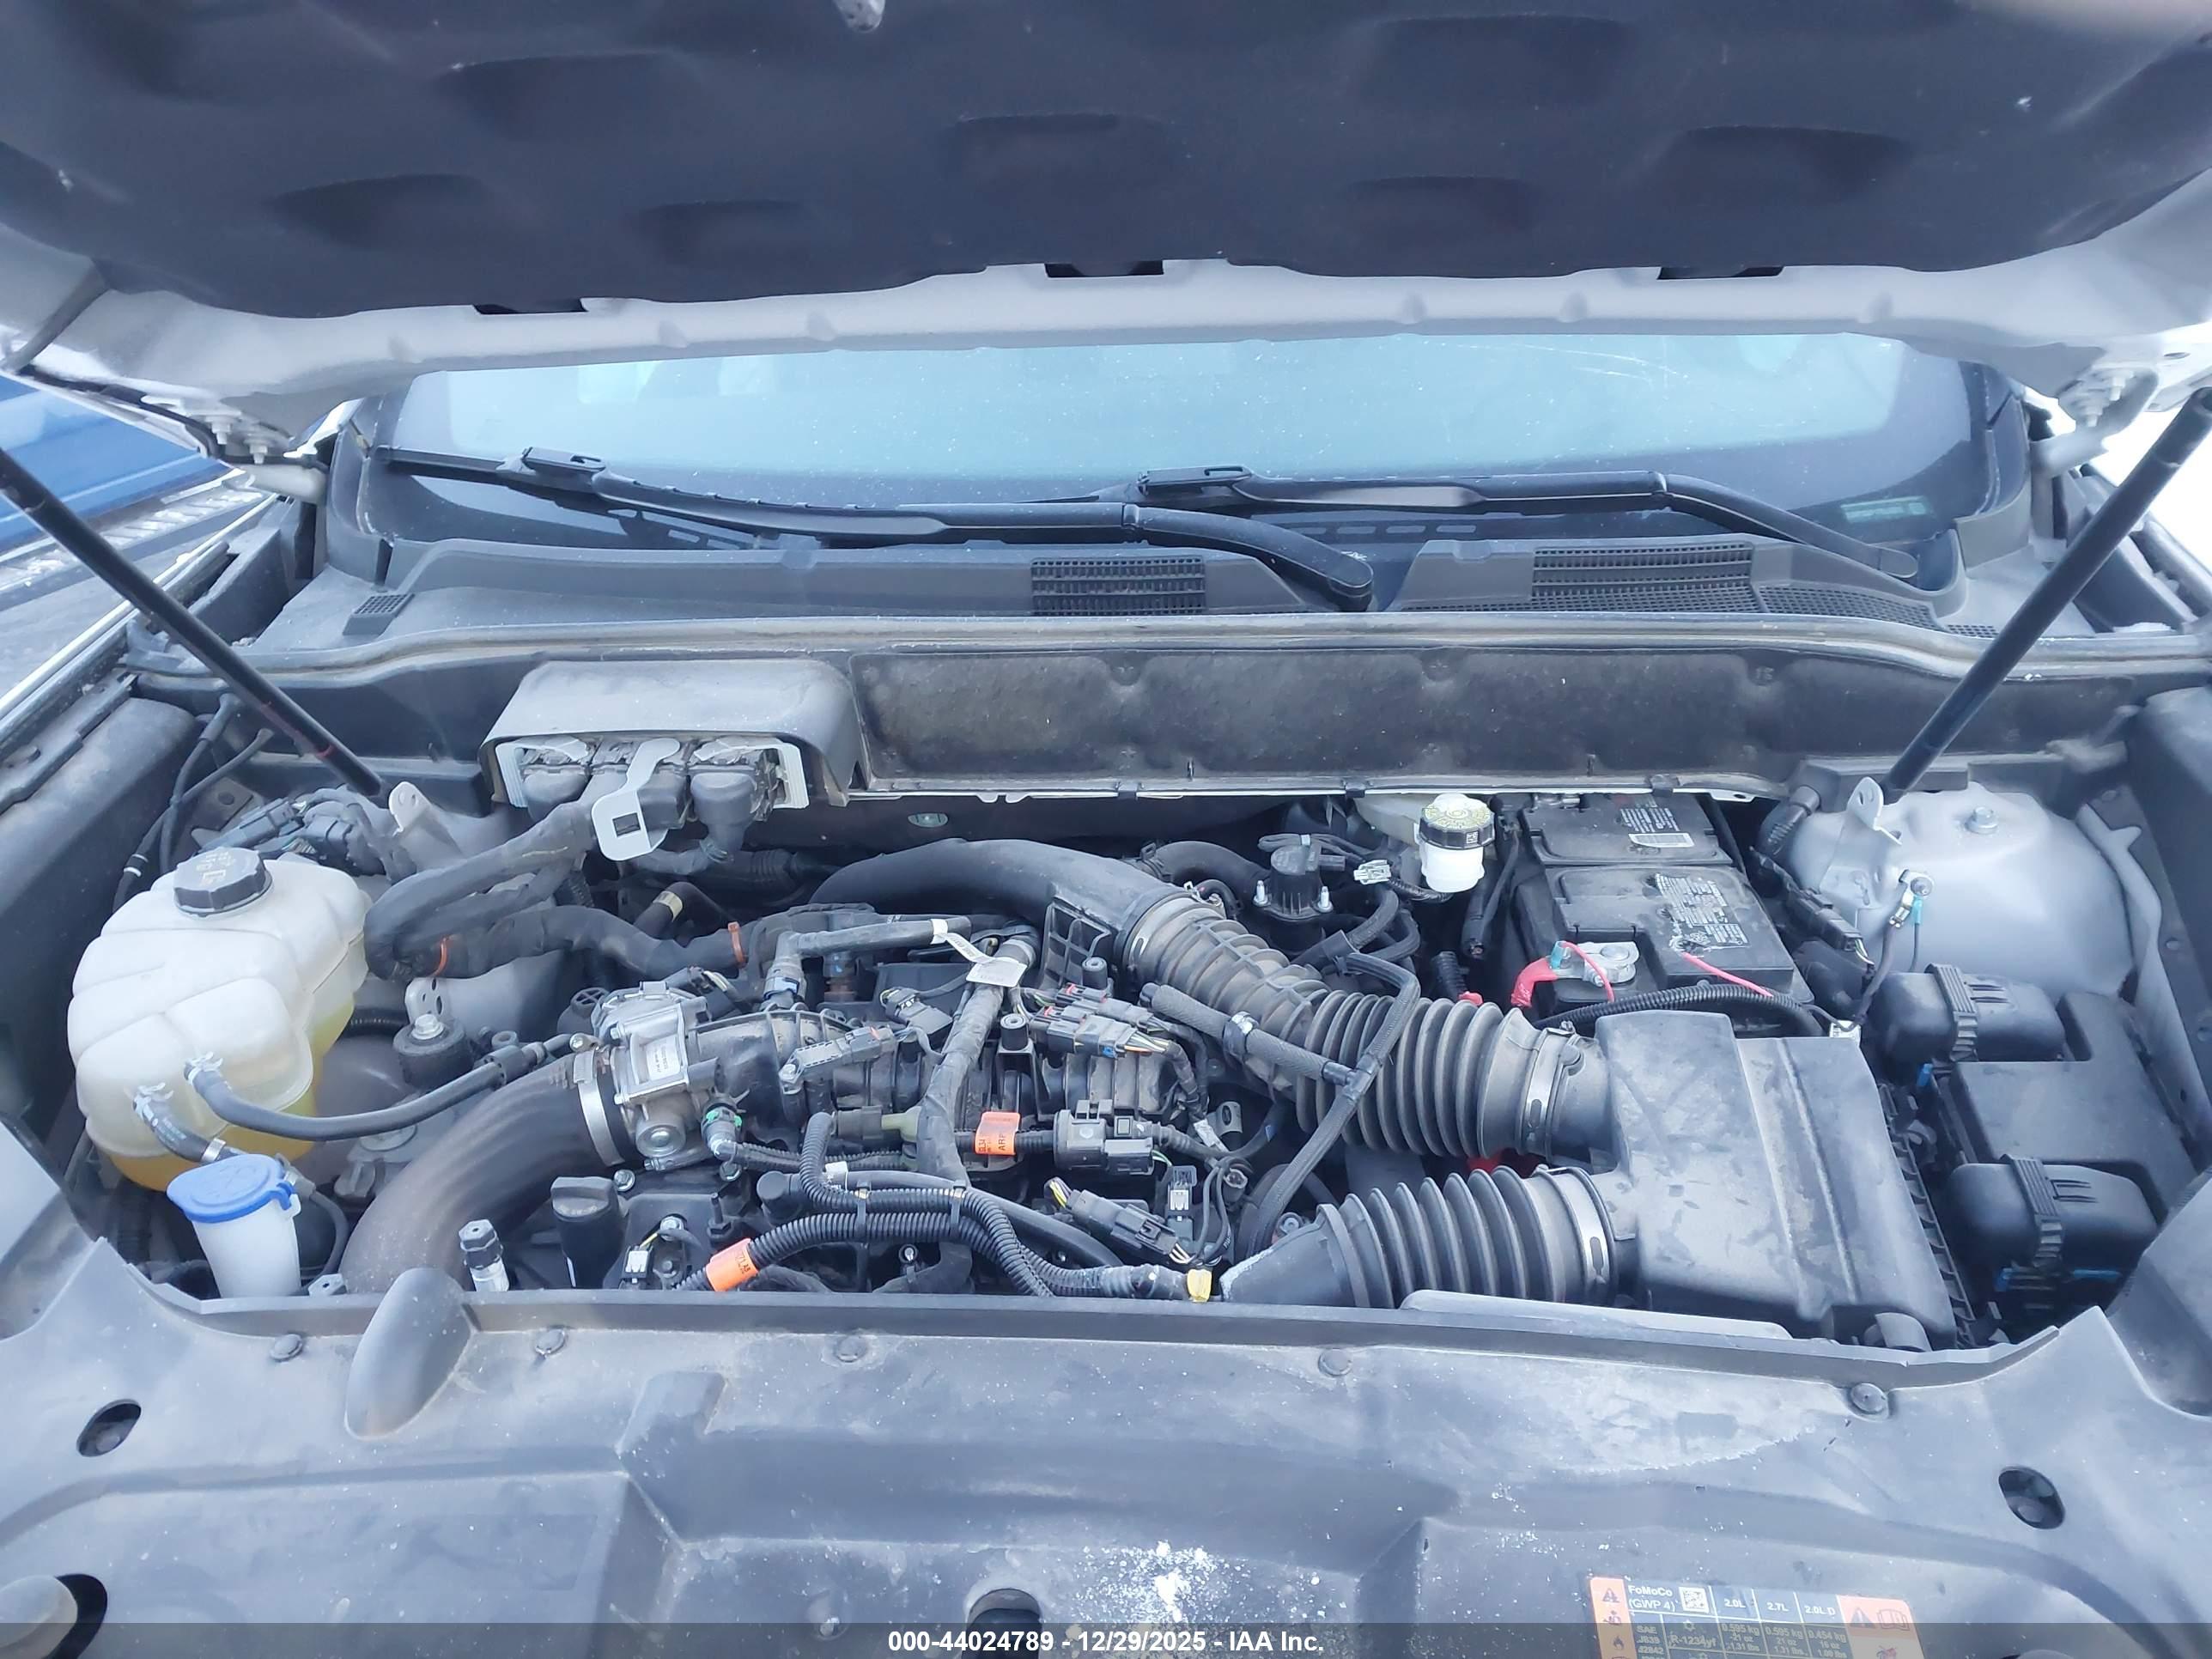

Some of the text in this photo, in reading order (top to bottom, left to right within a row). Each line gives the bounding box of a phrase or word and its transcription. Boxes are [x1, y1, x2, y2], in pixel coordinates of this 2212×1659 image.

[1628, 1585, 1673, 1596] FoMoCo
[1628, 1598, 1675, 1612] (GWP 4)
[1724, 1599, 1746, 1608] 2.0L
[1766, 1601, 1789, 1612] 2.7L
[1804, 1605, 1836, 1615] 2.0L D
[1637, 1626, 1657, 1634] SAE
[1747, 1625, 1759, 1636] kg
[1670, 1634, 1717, 1649] R-1234yf
